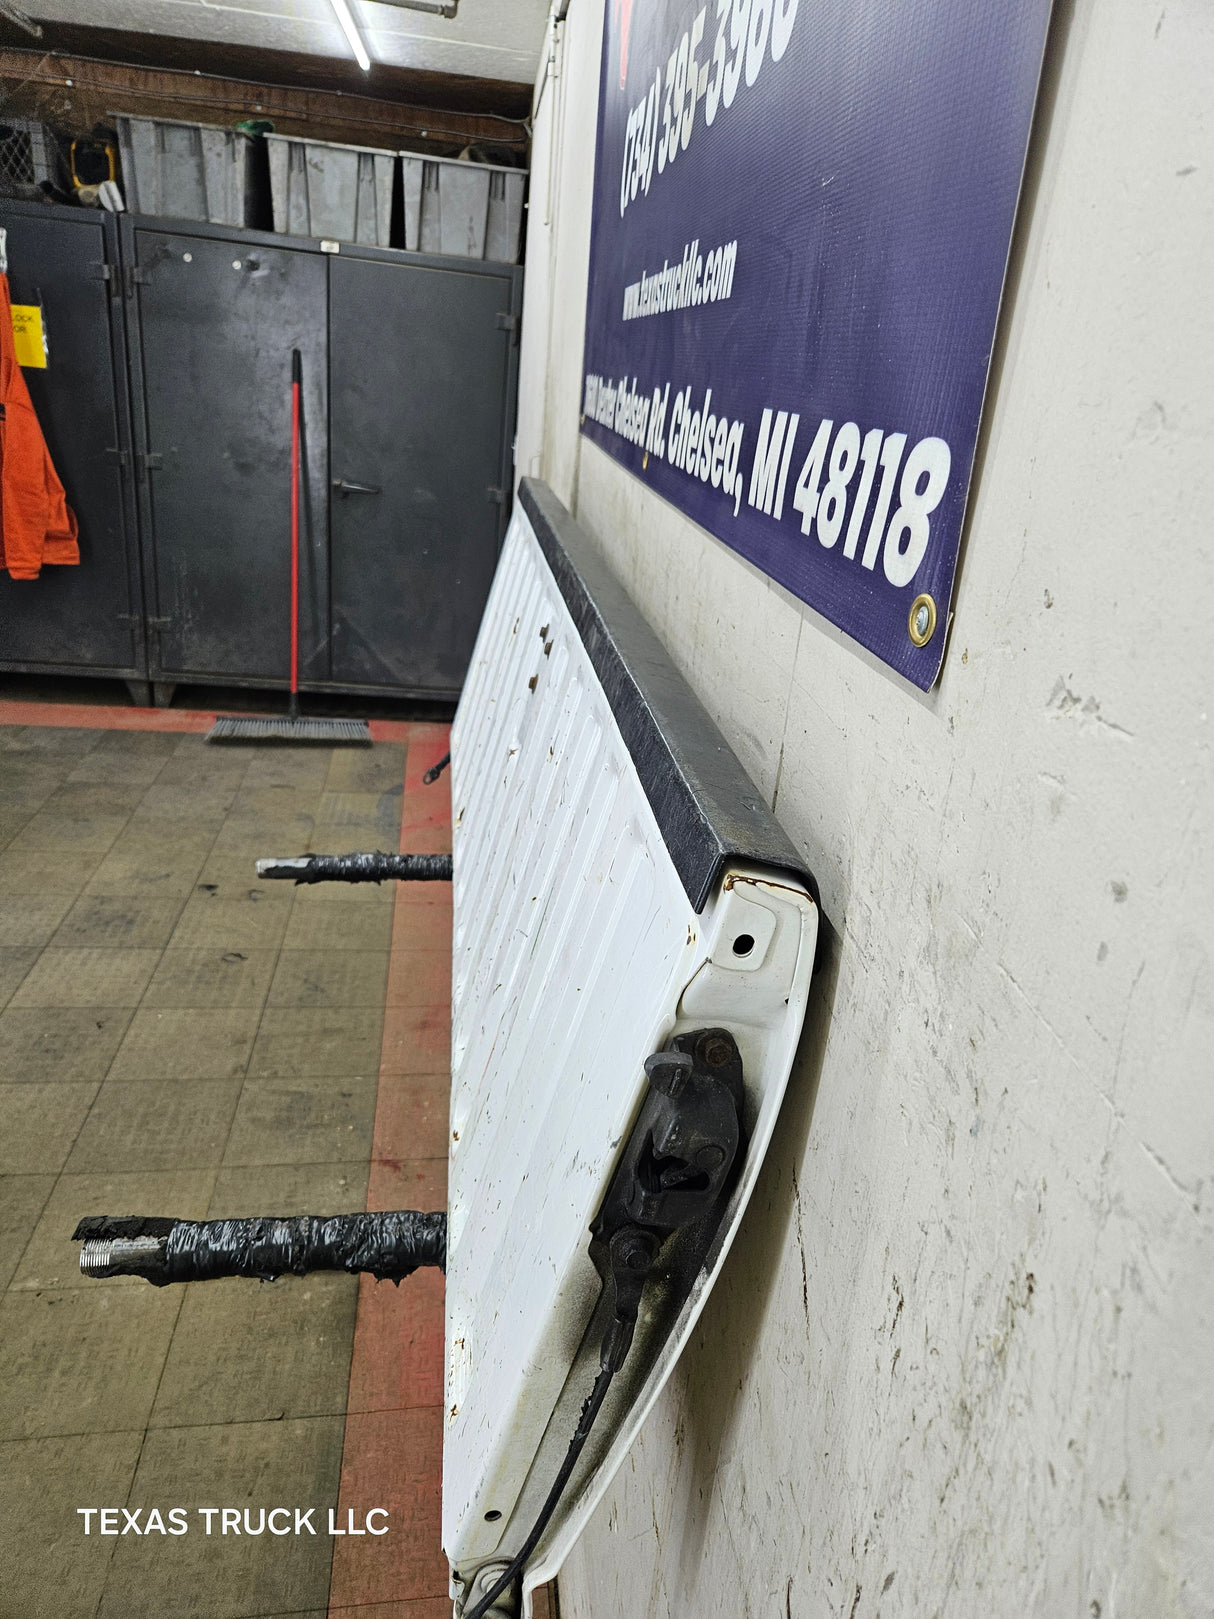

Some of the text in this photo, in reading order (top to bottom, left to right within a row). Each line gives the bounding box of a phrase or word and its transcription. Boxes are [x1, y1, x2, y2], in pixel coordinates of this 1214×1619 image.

[620, 66, 661, 218] (734)
[645, 382, 670, 459] Rd.
[668, 385, 744, 517] Chelsea,
[748, 408, 800, 520] MI
[793, 419, 951, 587] 48118
